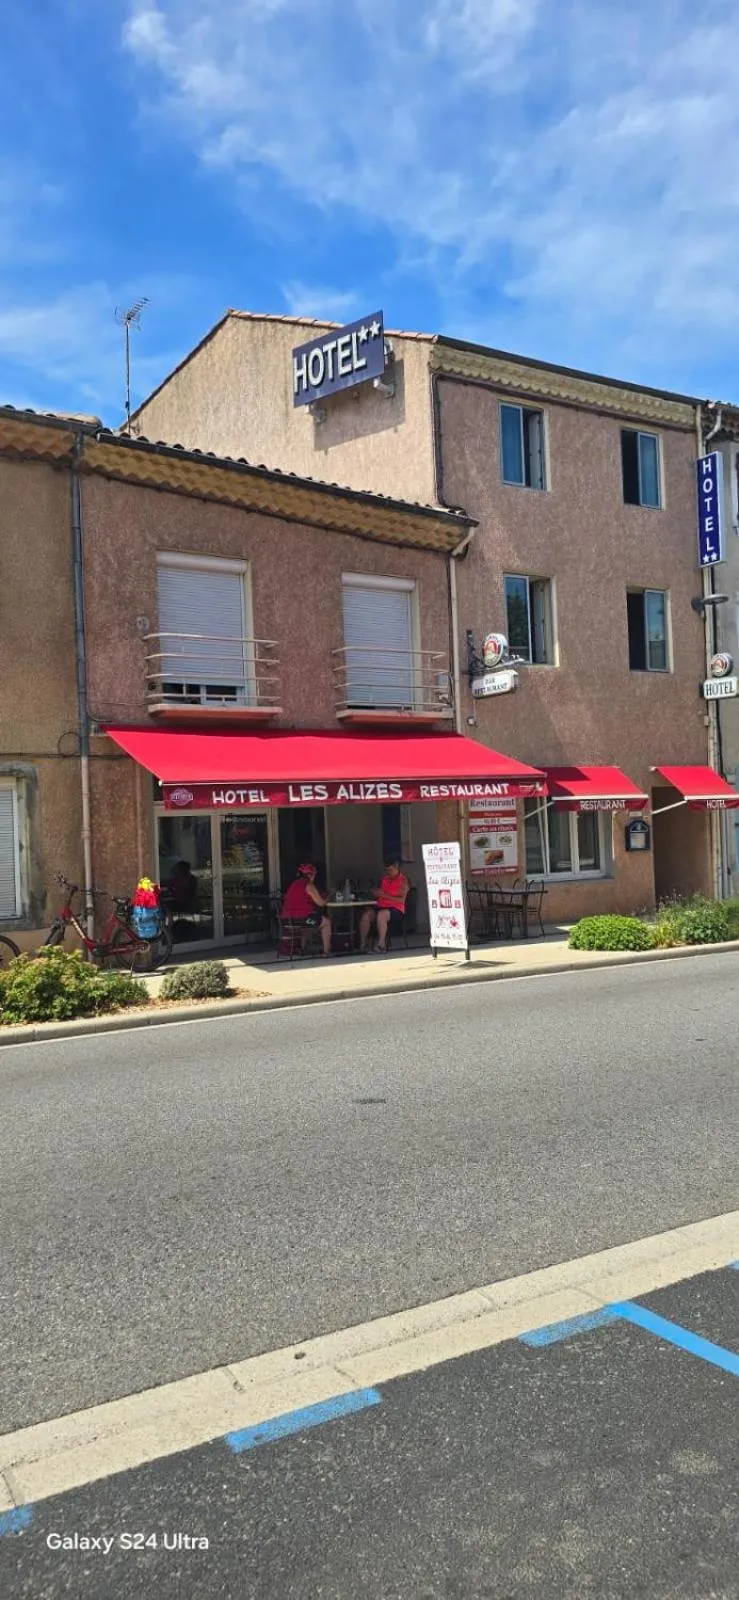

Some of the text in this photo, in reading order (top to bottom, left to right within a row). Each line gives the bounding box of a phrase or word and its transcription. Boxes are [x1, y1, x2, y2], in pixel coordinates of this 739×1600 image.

[293, 331, 367, 393] HOTEL
[702, 458, 715, 552] HOTEL
[706, 680, 735, 696] HOTEL
[212, 790, 270, 804] HOTEL
[288, 785, 328, 802] LES
[420, 783, 509, 797] RESTAURANT
[580, 800, 626, 810] RESTAURANT
[706, 800, 726, 809] HOTEL
